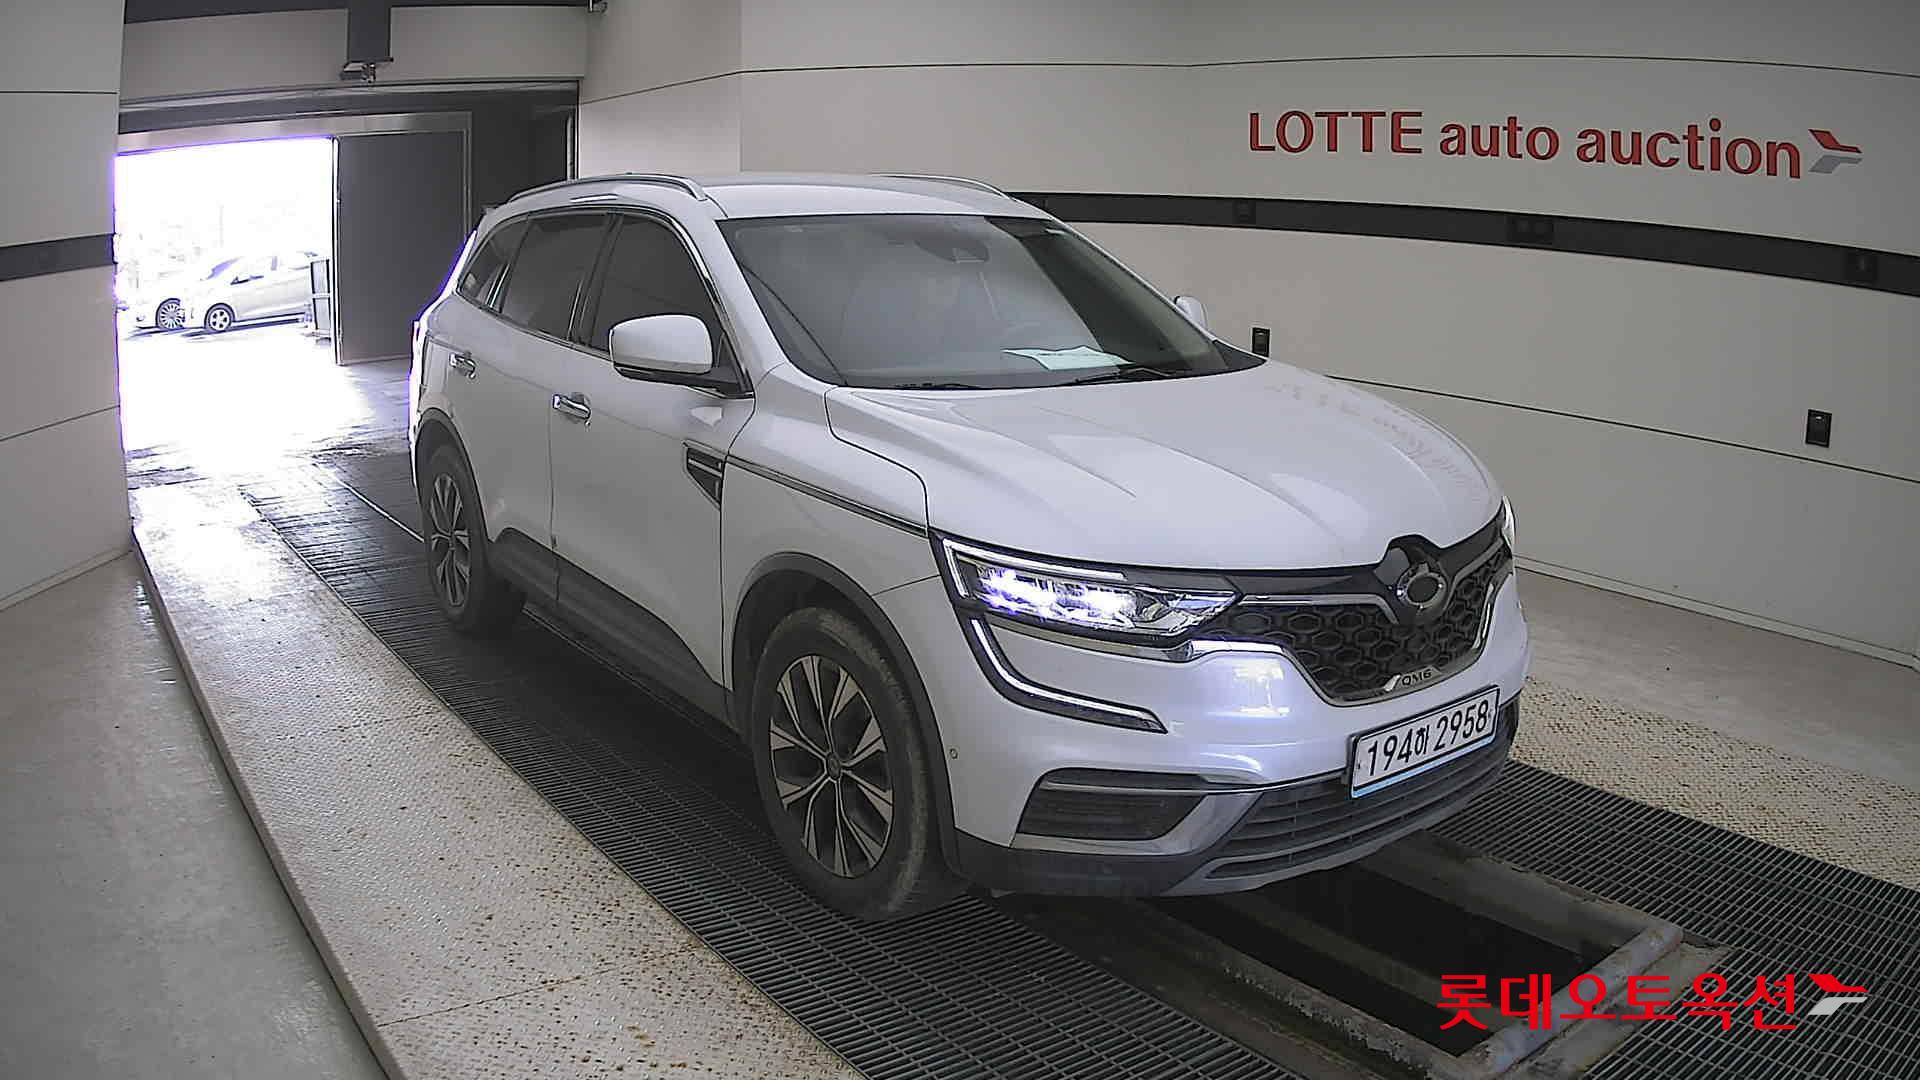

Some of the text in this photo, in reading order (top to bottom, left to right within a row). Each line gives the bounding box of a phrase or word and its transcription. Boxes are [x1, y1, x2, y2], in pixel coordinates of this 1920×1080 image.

[1249, 110, 1801, 179] LOTTE auto auction
[1433, 699, 1490, 752] 2958
